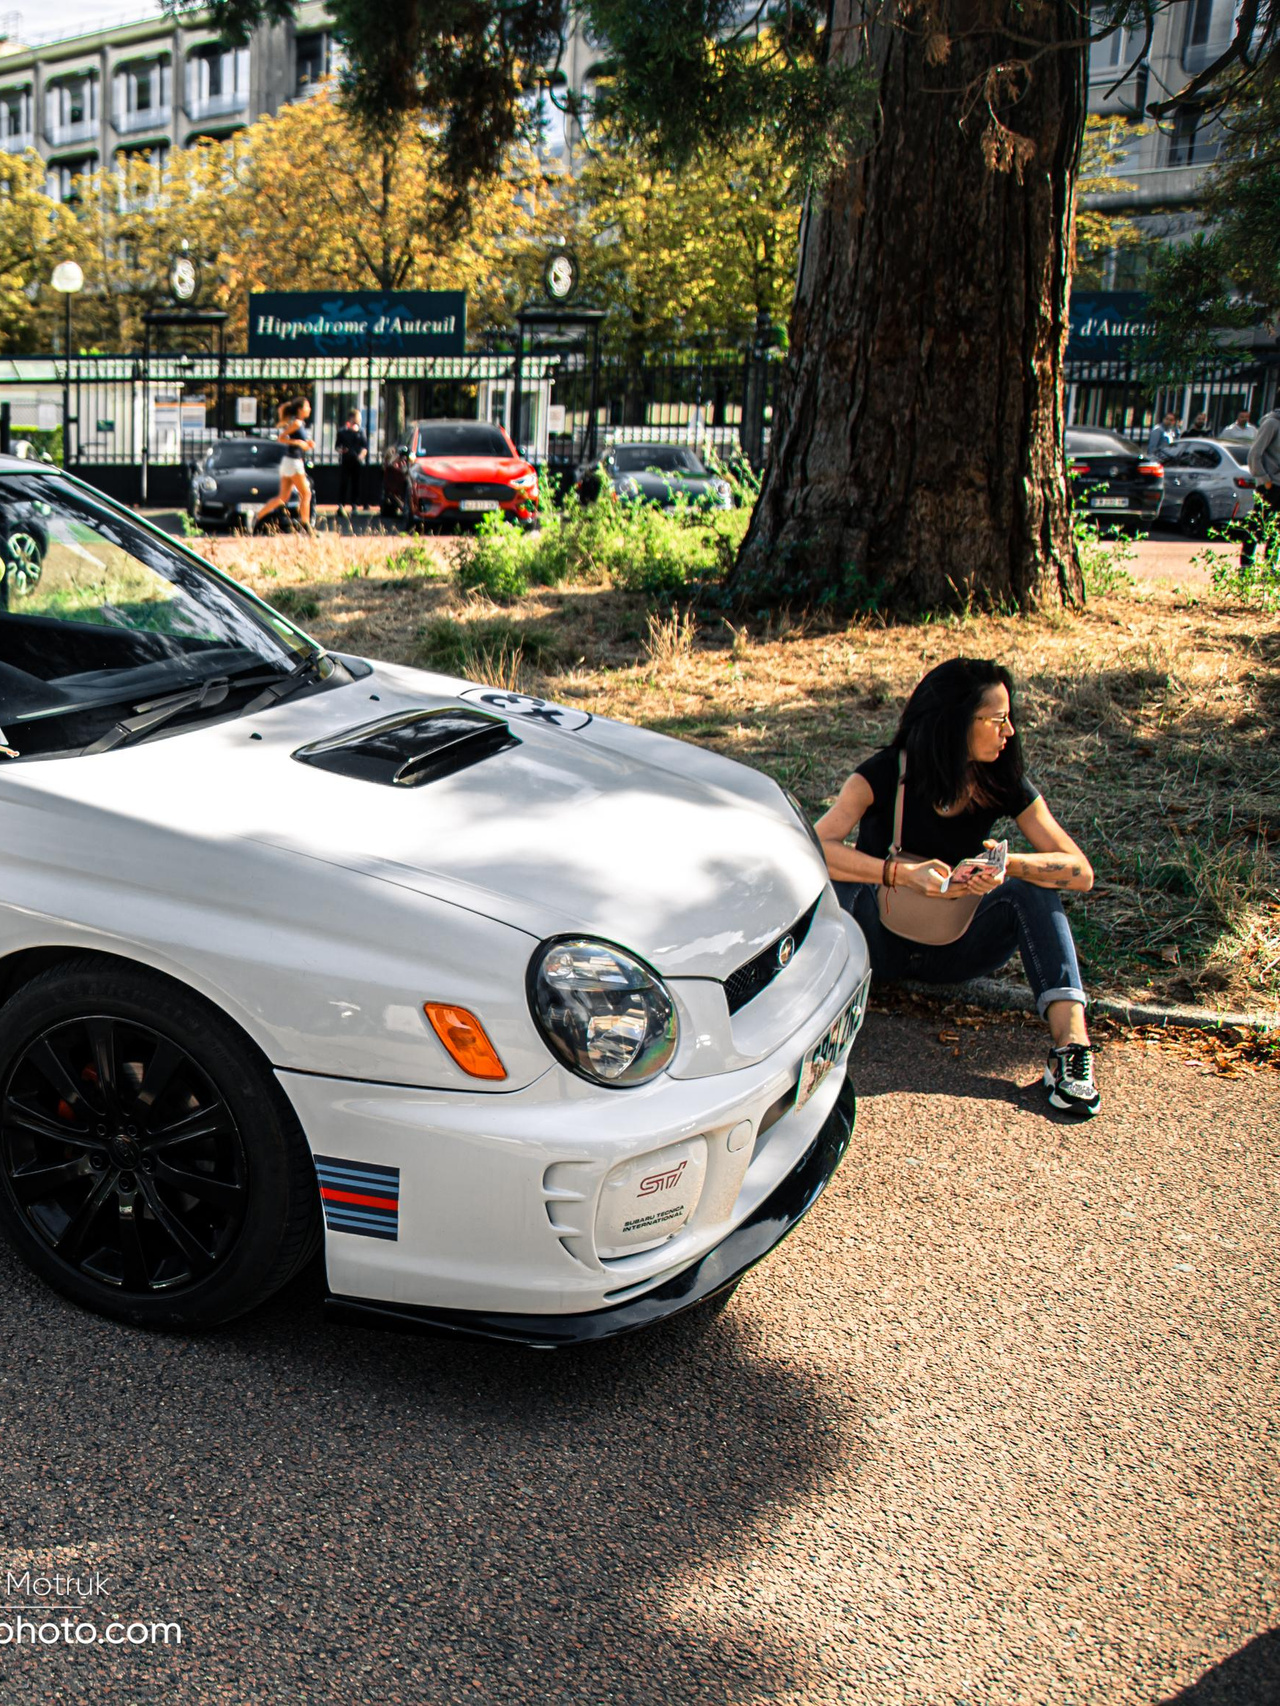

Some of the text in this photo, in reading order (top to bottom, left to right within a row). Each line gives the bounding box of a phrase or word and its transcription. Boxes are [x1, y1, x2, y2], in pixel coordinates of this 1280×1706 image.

[257, 315, 456, 341] Hippodrome d'Auteuil
[622, 1211, 683, 1233] INTERNATIONAL
[624, 1205, 685, 1227] SUBARU TECNICA
